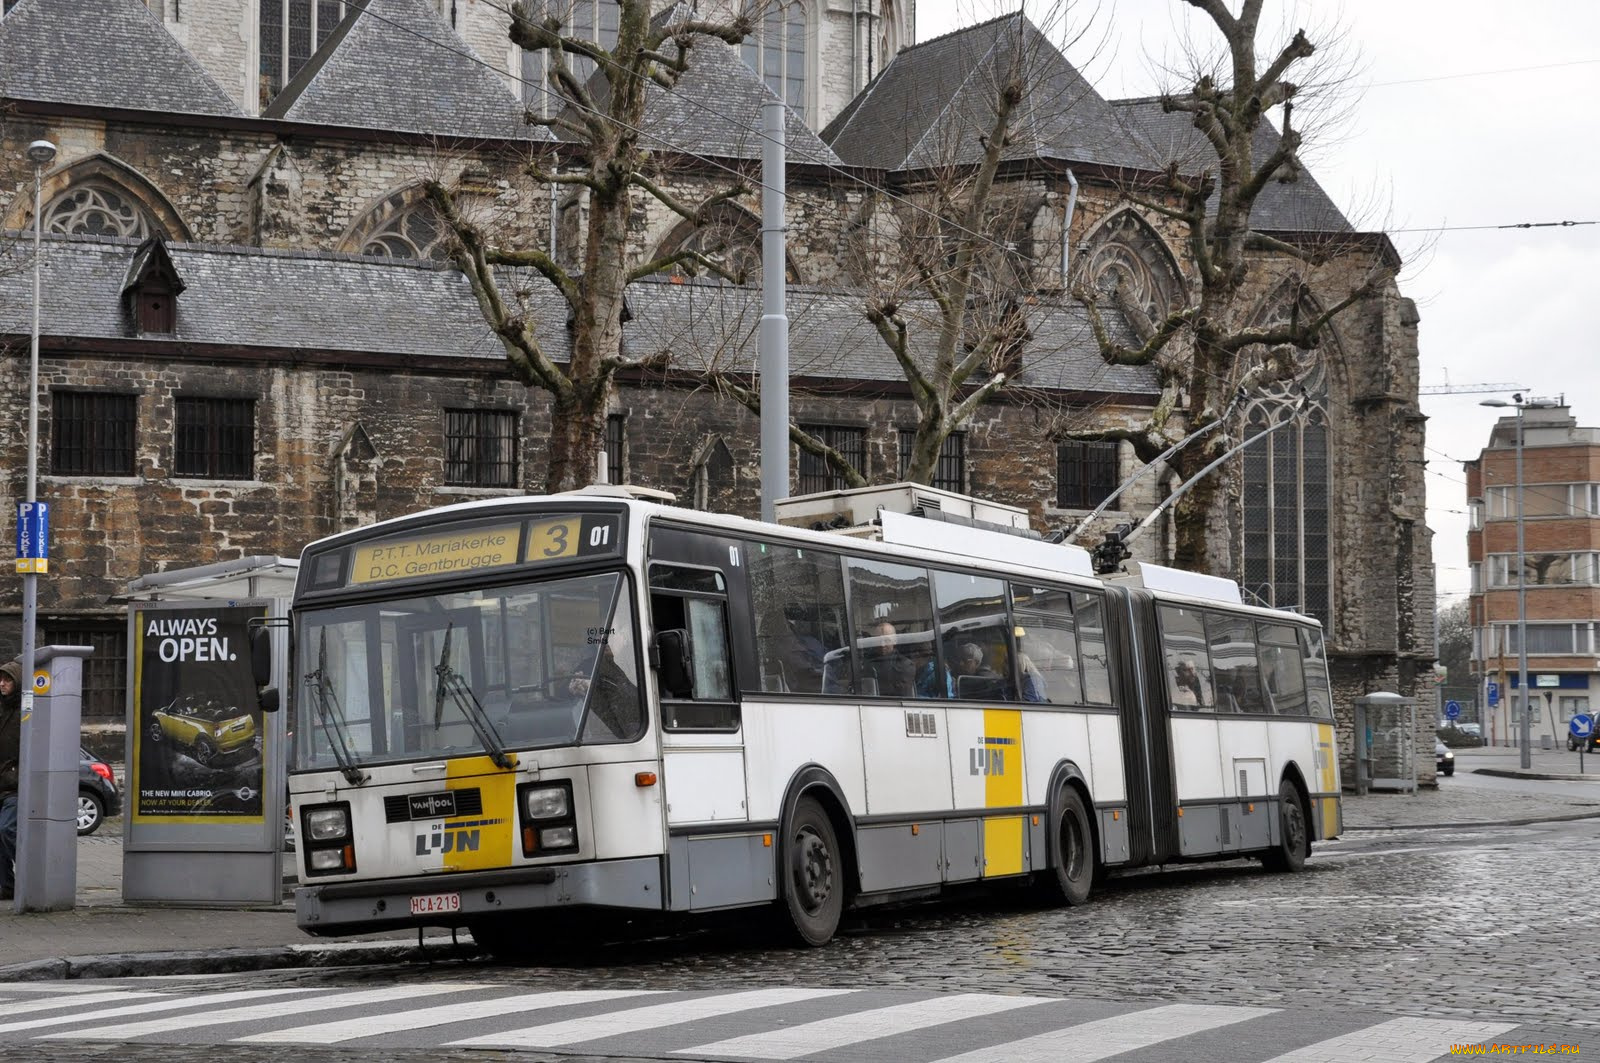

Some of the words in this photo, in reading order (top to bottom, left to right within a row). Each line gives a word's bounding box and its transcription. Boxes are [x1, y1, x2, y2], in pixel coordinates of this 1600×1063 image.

[20, 503, 32, 517] P
[38, 503, 46, 517] P
[21, 517, 30, 558] TICKET
[371, 545, 411, 561] P.T.T.
[415, 534, 506, 556] Mariakerke
[543, 524, 569, 557] 3
[589, 525, 610, 547] 01
[369, 563, 400, 579] D.C.
[405, 552, 502, 574] Gentbrugge
[729, 545, 739, 566] 01
[146, 618, 217, 636] ALWAYS
[158, 637, 237, 663] OPEN.
[970, 748, 1004, 775] LIJN
[416, 830, 480, 856] LIJN
[412, 896, 459, 912] HCA-219
